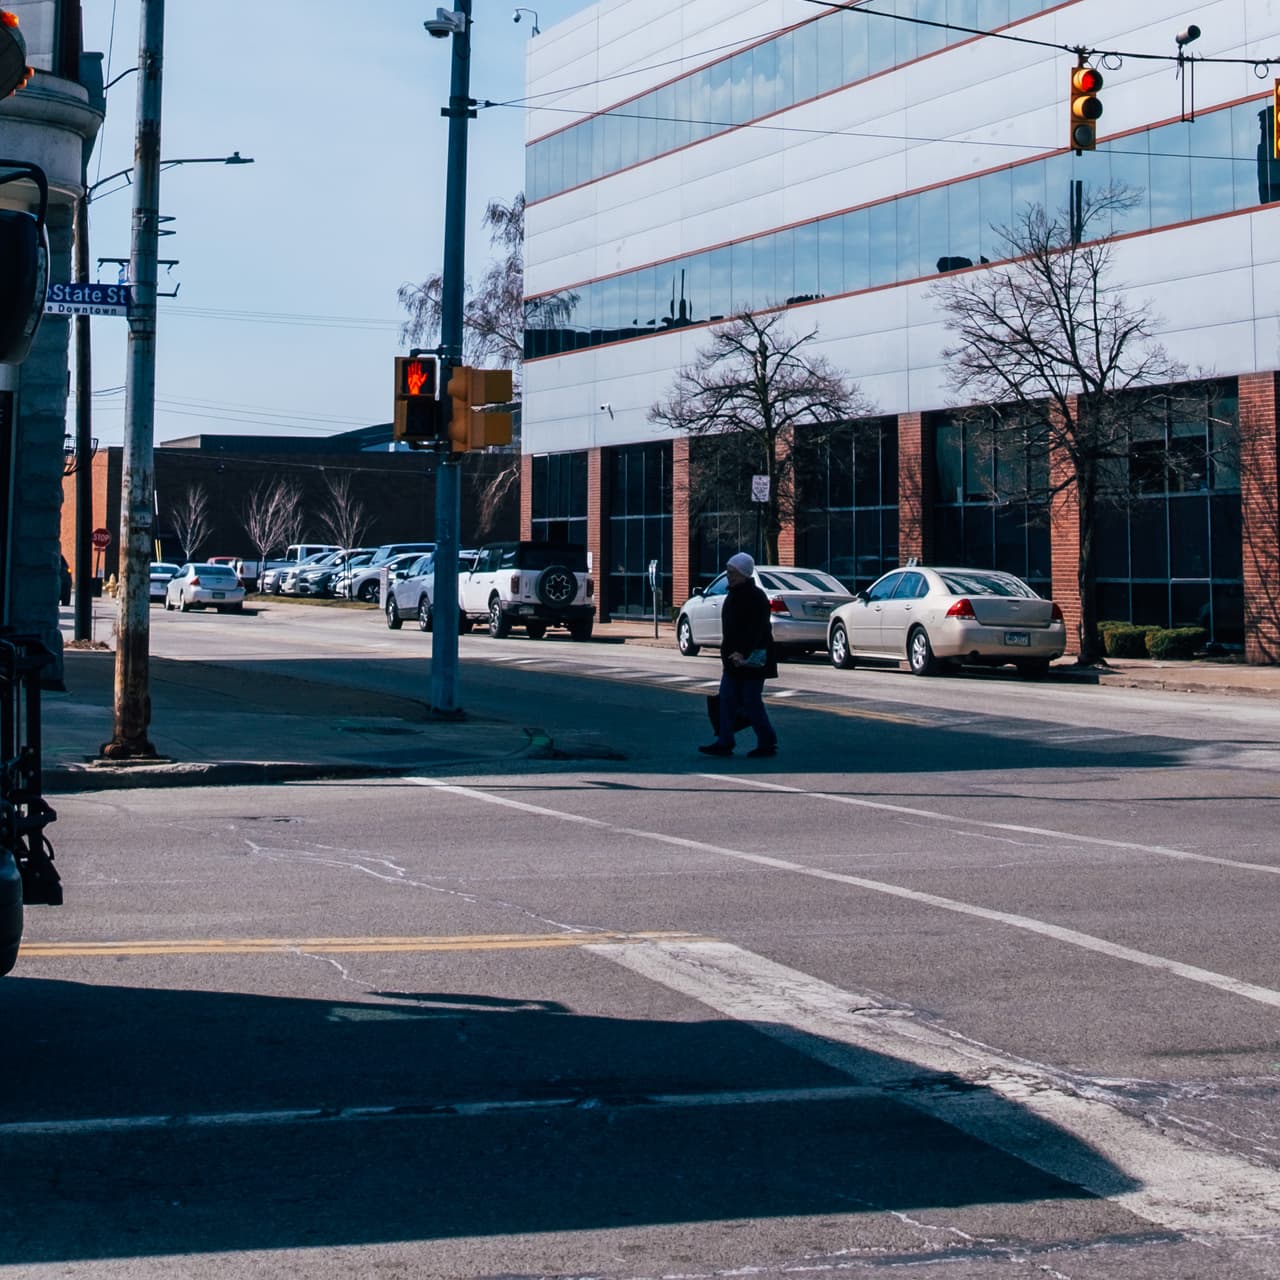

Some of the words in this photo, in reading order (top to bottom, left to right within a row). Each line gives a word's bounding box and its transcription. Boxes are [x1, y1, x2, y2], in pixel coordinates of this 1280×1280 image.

[53, 283, 102, 303] State
[107, 289, 127, 304] St
[58, 304, 117, 315] Downtown
